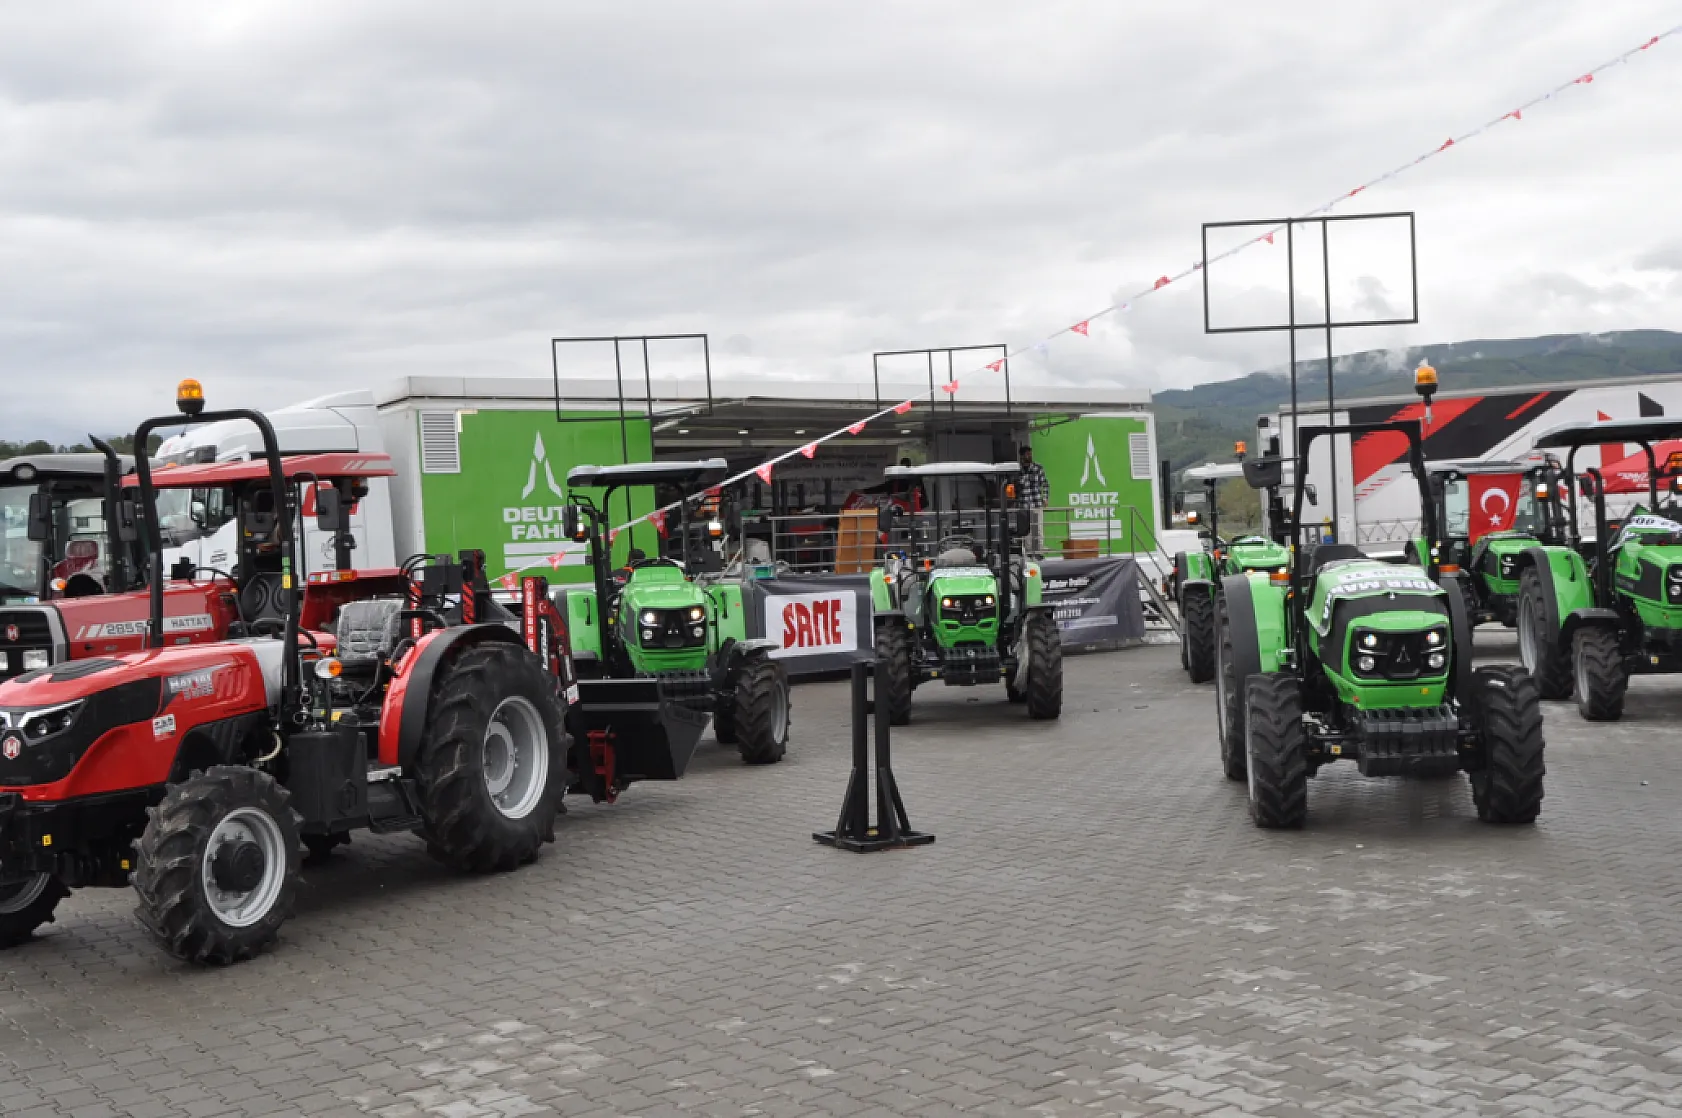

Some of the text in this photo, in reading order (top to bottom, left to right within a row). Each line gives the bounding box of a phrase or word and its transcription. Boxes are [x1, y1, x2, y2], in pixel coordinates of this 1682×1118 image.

[1069, 492, 1118, 506] DEUTZ
[504, 507, 582, 522] DEUT
[512, 524, 566, 540] FAH
[170, 617, 207, 628] HATTAT
[783, 599, 842, 649] SAME
